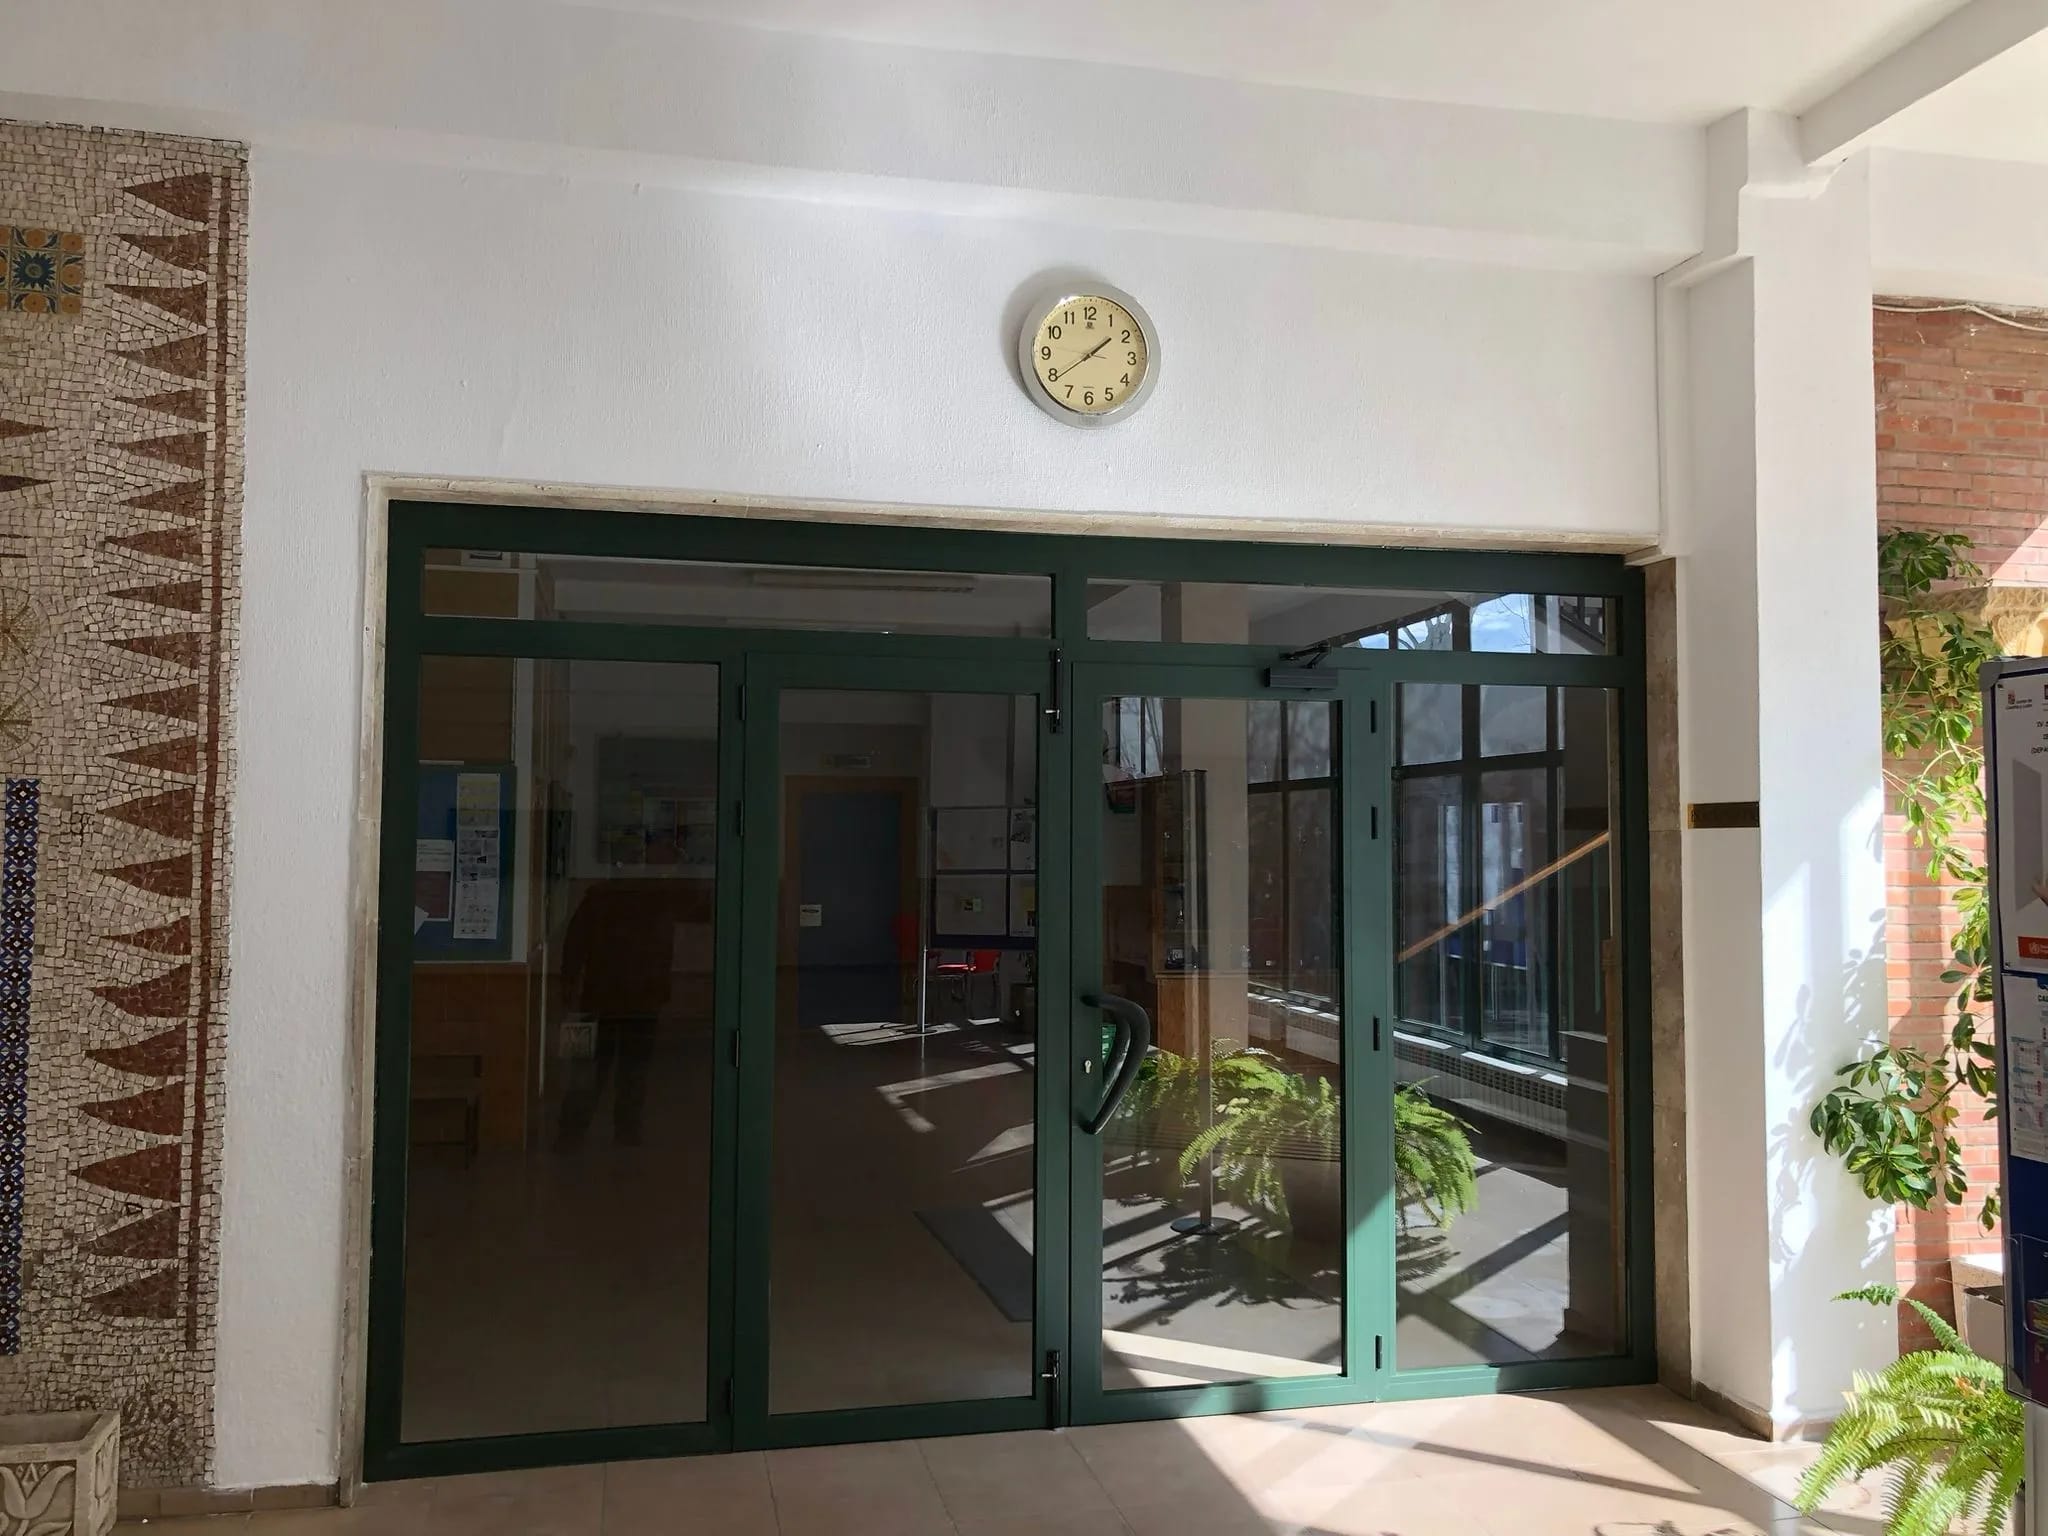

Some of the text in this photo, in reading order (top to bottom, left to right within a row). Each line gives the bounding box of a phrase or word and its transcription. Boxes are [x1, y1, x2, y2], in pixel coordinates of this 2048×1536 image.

[1064, 311, 1075, 325] 11
[1083, 306, 1097, 321] 12
[1108, 314, 1113, 328] 1
[1047, 325, 1062, 340] 10
[1121, 329, 1131, 344] 2
[1042, 346, 1051, 360] 9
[1127, 351, 1137, 366] 3
[1047, 367, 1059, 383] 8
[1120, 373, 1130, 387] 4
[1064, 384, 1074, 399] 7
[1084, 391, 1094, 405] 6
[1104, 387, 1114, 402] 5
